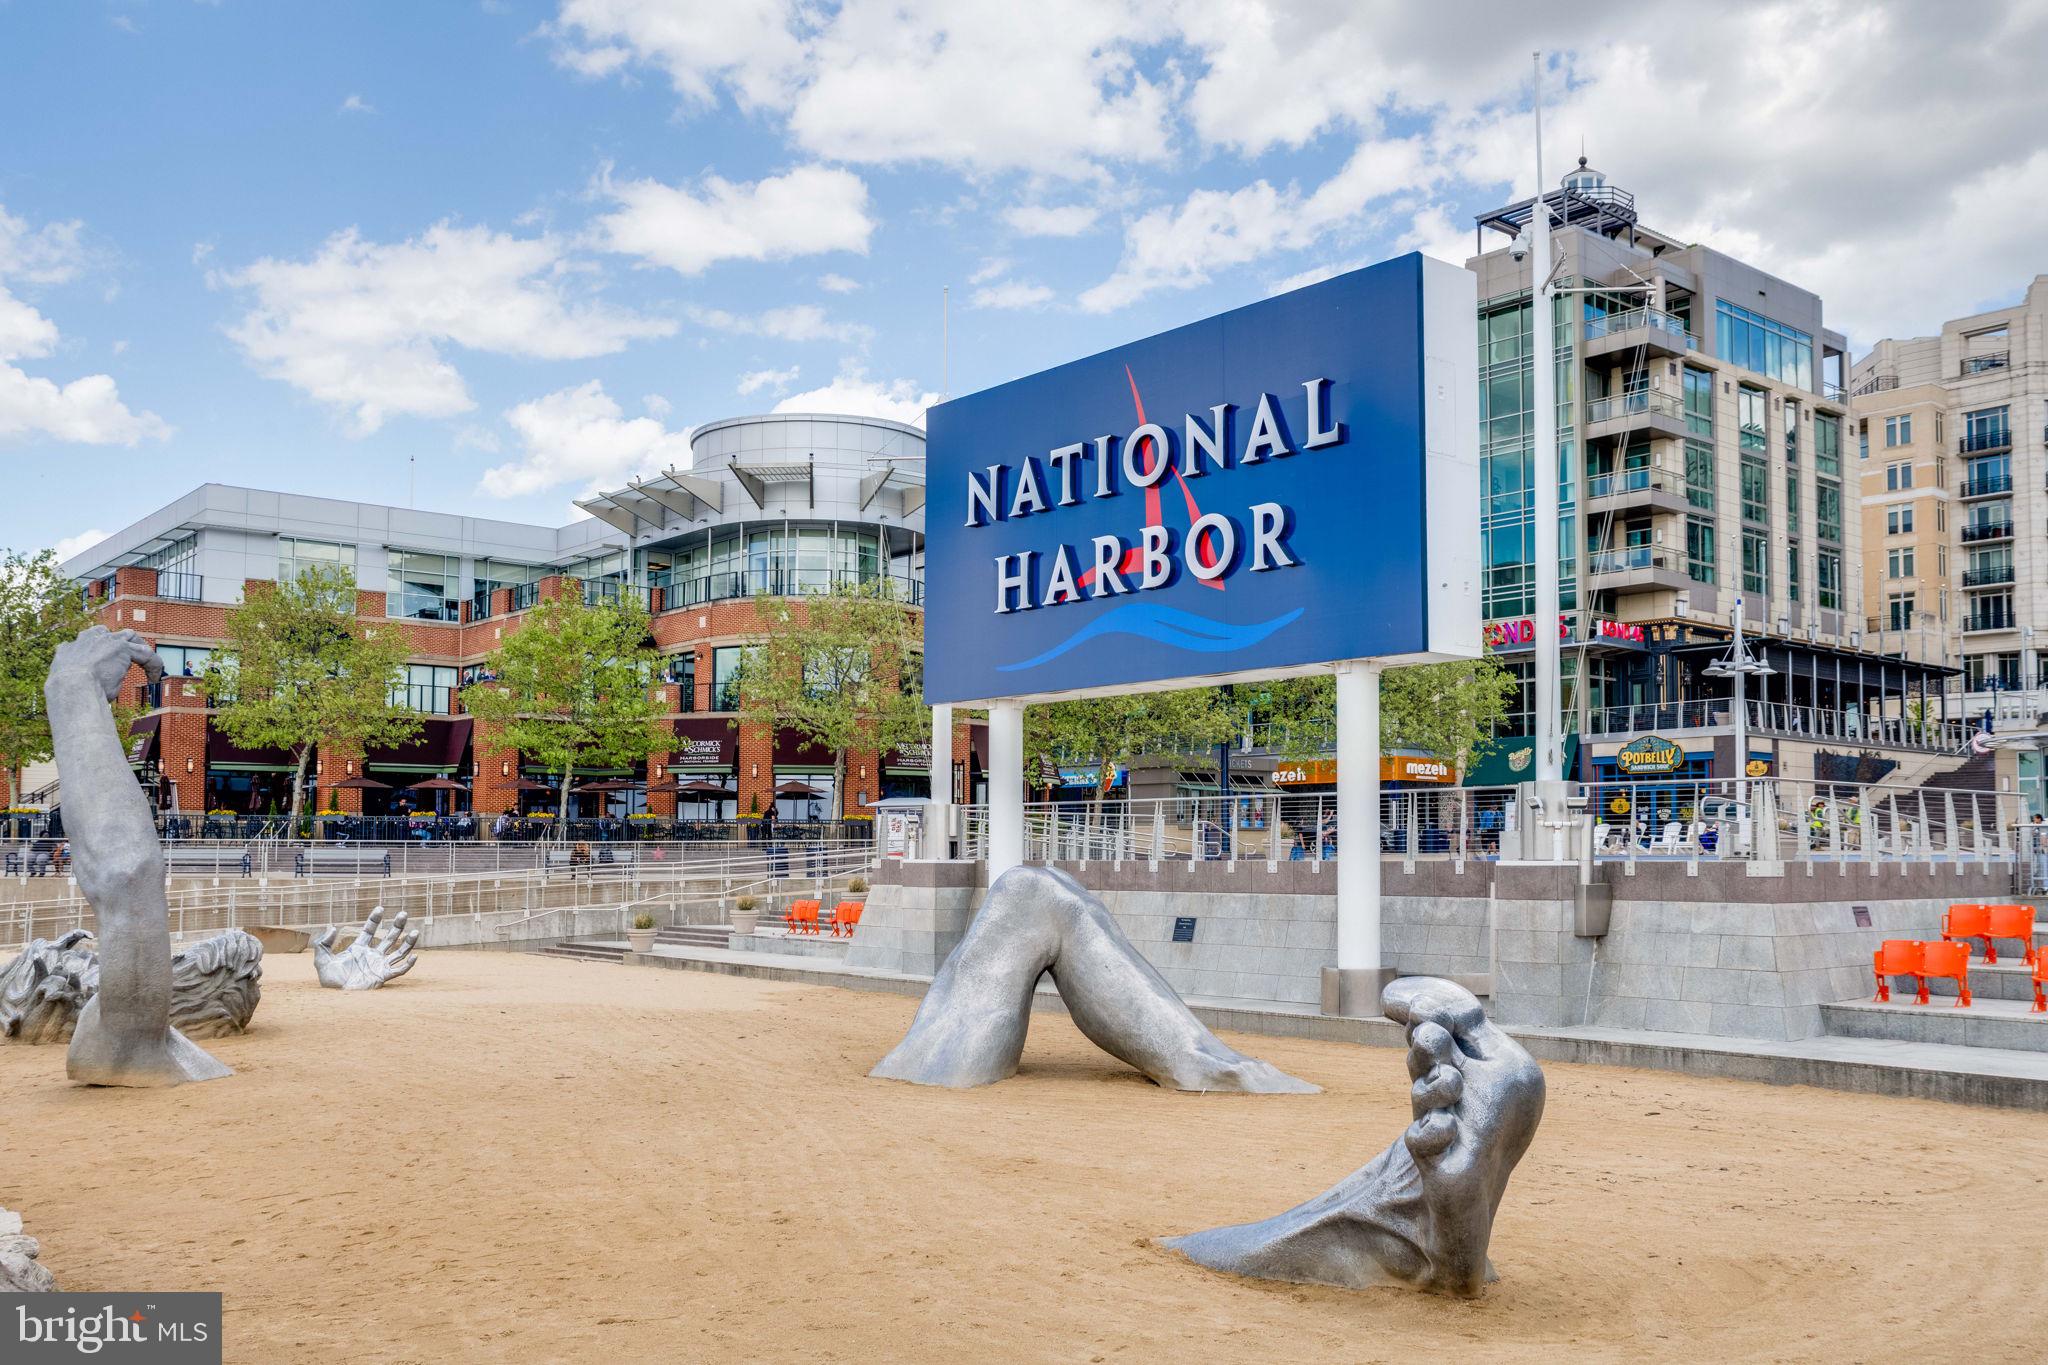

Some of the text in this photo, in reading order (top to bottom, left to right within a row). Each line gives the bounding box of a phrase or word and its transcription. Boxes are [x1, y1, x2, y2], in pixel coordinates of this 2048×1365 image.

[964, 377, 1343, 527] NATIONAL
[994, 502, 1296, 614] HARBOR
[1484, 619, 1535, 645] OND
[1602, 619, 1645, 643] BOND 45
[1406, 761, 1448, 776] mezeh
[1621, 746, 1677, 767] POTBELLY
